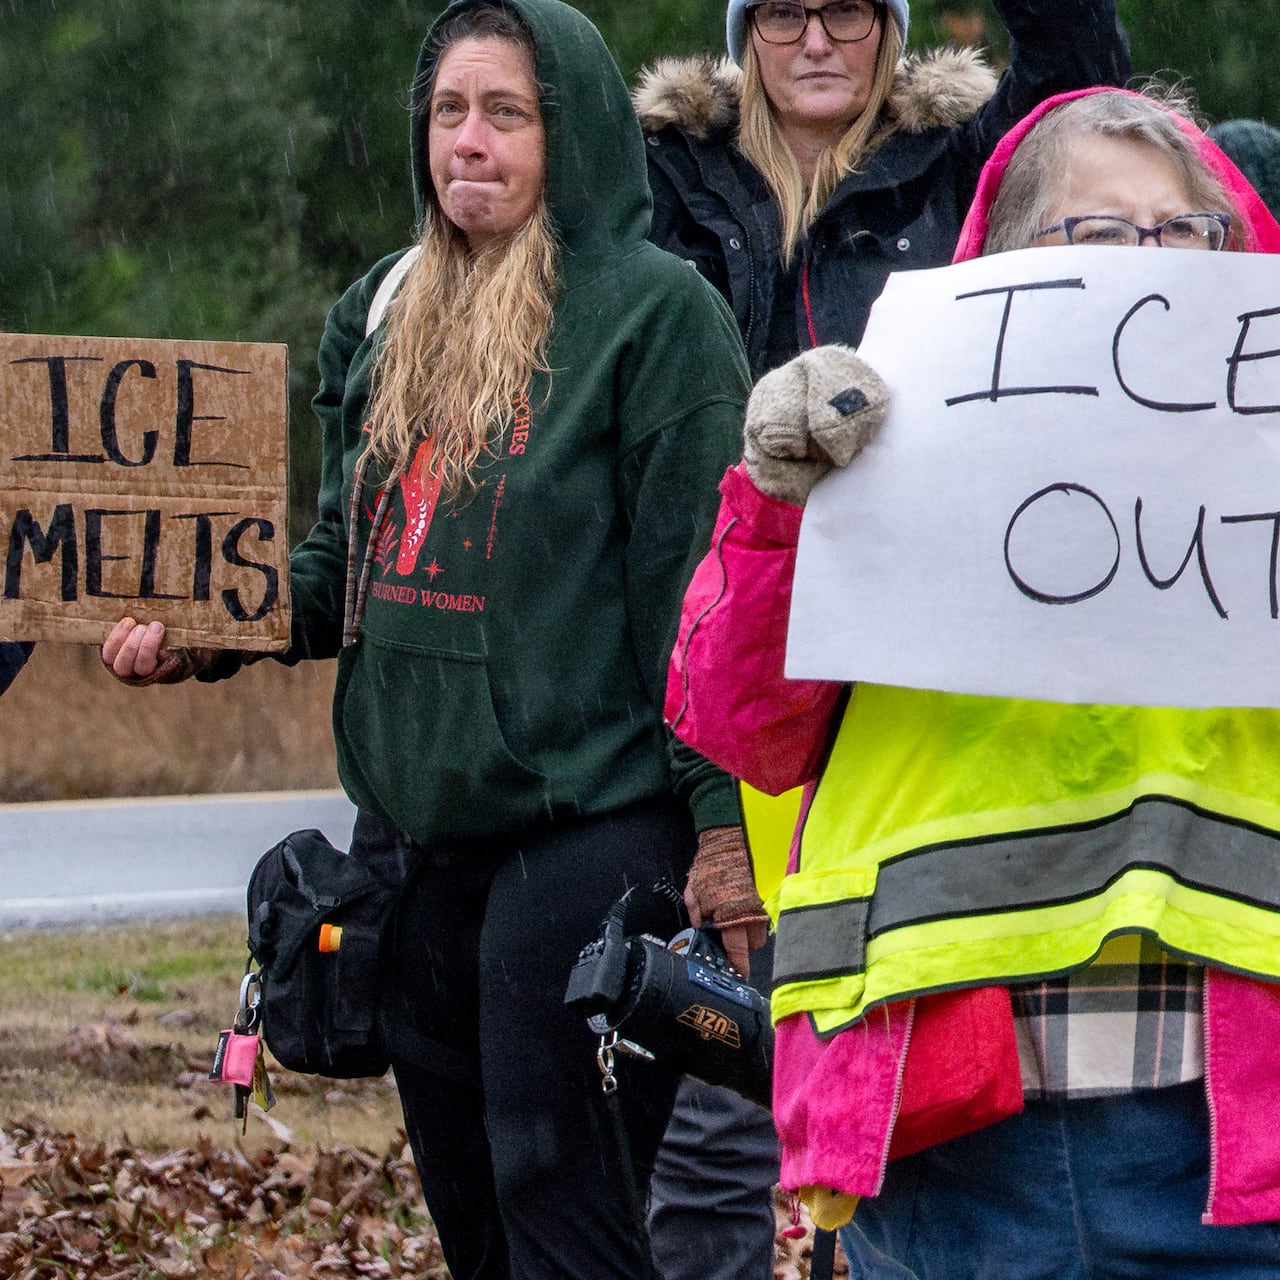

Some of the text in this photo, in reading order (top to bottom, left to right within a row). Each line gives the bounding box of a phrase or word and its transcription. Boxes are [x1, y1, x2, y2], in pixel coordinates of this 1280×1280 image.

[9, 356, 252, 469] ICE
[509, 391, 530, 455] TCHES
[2, 503, 279, 622] MELTS
[372, 581, 485, 613] BURNED WOMEN
